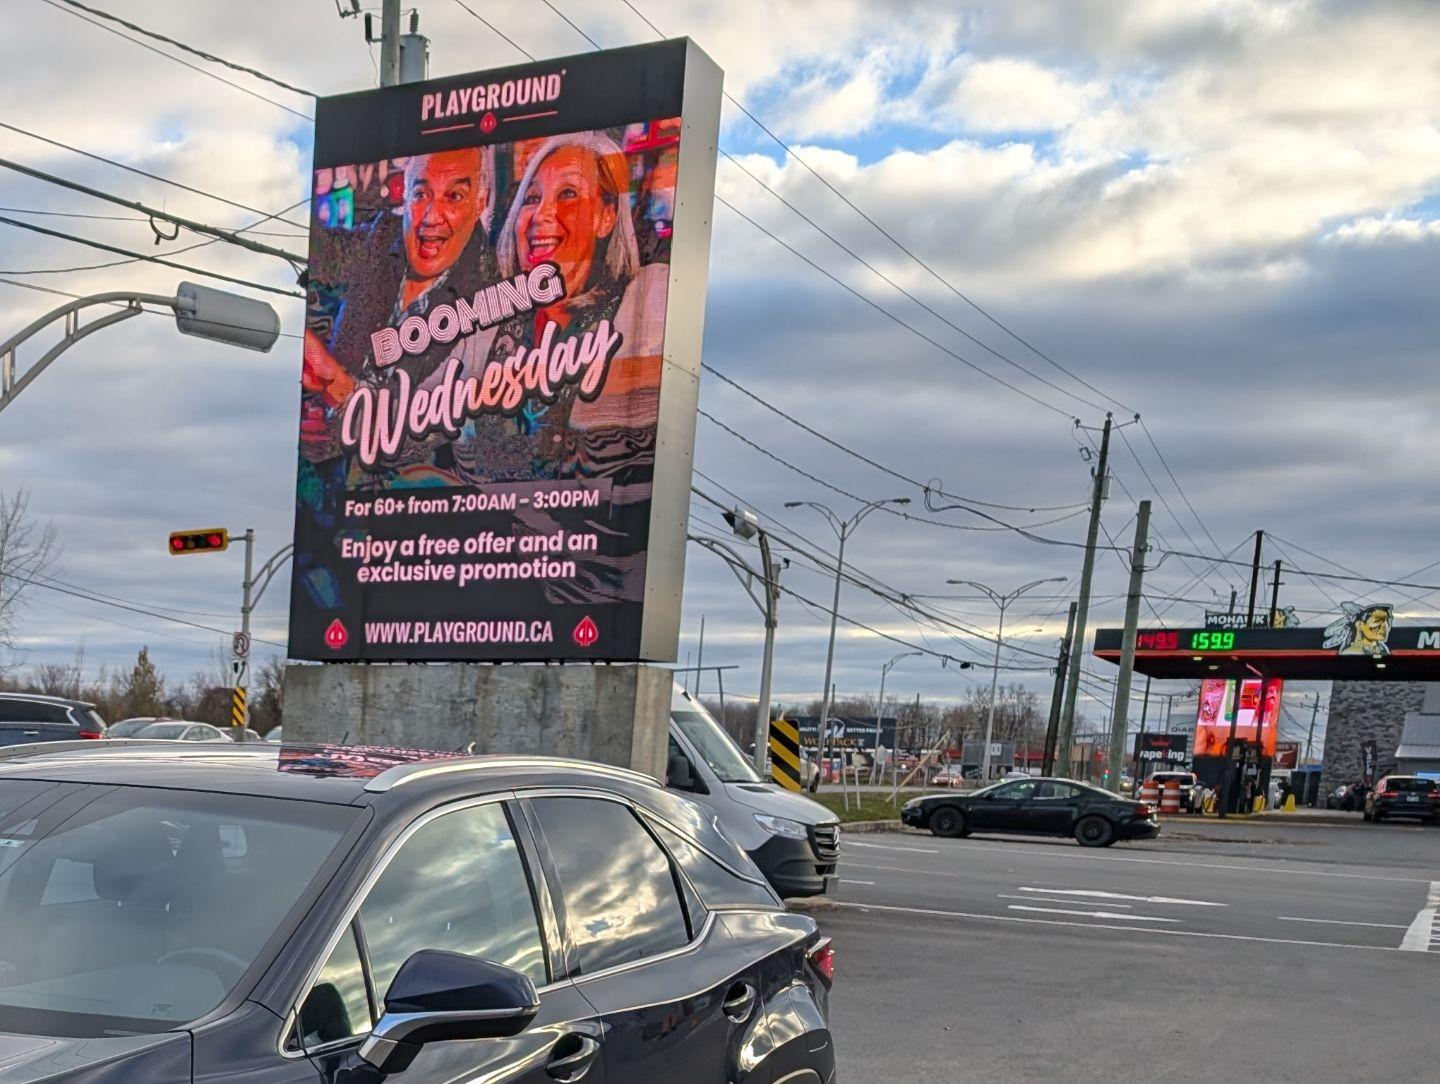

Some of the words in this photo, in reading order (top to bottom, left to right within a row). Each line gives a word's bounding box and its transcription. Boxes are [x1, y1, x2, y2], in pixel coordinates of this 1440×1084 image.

[421, 73, 561, 121] PLAYGROUND
[370, 263, 564, 368] BOOMING
[341, 319, 619, 465] Wednesday
[345, 499, 372, 517] For
[374, 497, 406, 516] 60+
[408, 495, 449, 515] from
[452, 493, 517, 513] 7:00AM
[533, 489, 600, 509] 3:00PM
[341, 535, 398, 564] Enjoy
[400, 540, 415, 556] a
[418, 533, 460, 556] free
[463, 531, 516, 554] offer
[518, 529, 564, 552] and
[567, 533, 598, 551] an
[357, 559, 456, 583] exclusive
[459, 555, 576, 587] promotion
[364, 620, 554, 644] WWW.PLAYGROUND.CA
